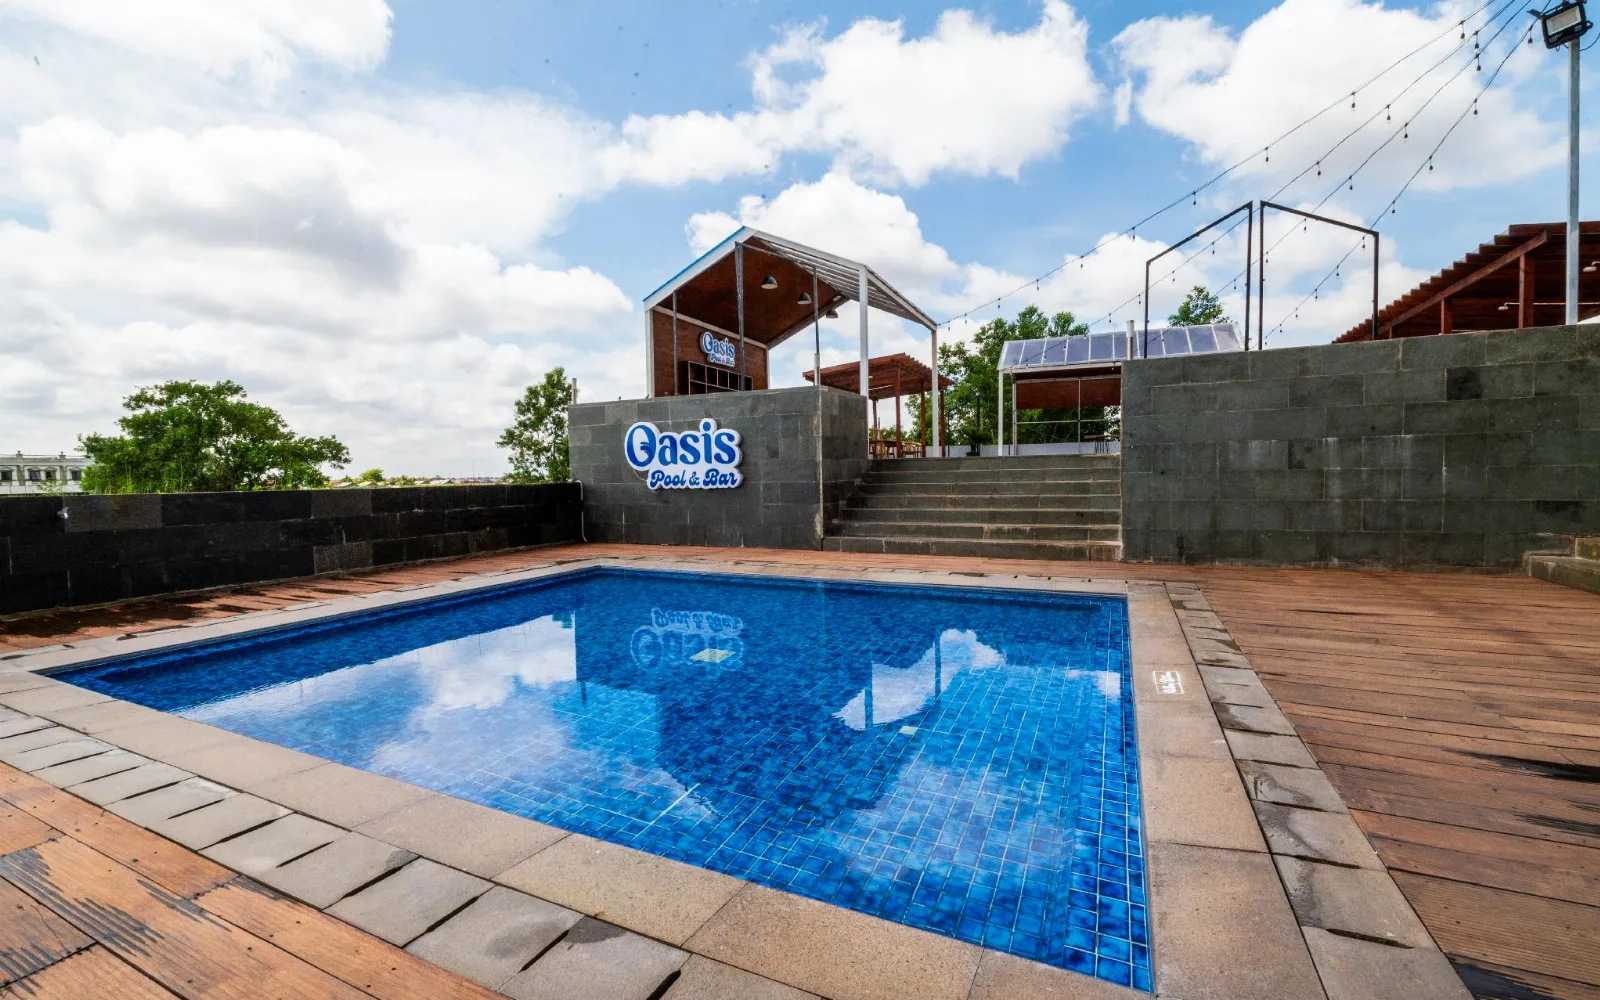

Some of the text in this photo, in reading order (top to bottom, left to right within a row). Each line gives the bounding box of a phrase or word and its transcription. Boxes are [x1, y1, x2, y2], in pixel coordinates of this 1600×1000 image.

[703, 332, 735, 358] Oasis
[626, 421, 736, 467] Oasis
[650, 468, 738, 488] Pool & Bar
